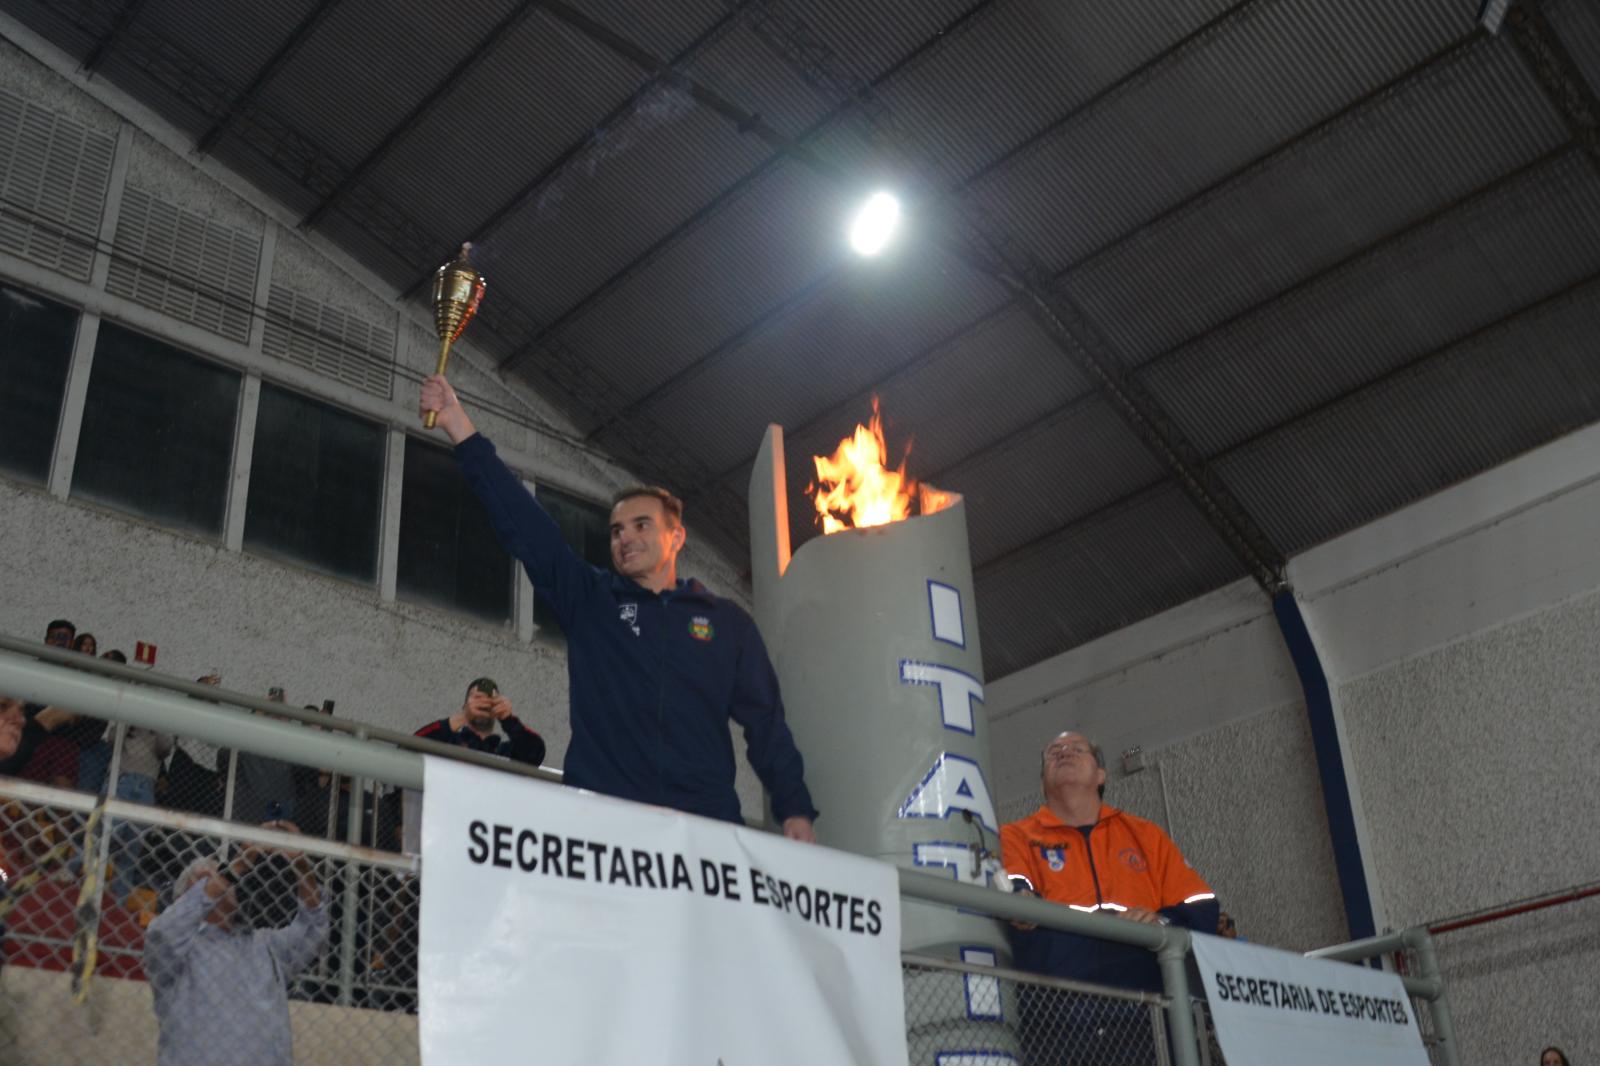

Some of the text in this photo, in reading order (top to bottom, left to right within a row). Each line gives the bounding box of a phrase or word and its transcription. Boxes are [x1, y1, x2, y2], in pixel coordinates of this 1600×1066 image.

[468, 820, 882, 936] SECRETARIA DE ESPORTES
[897, 578, 1022, 1066] ITATI
[1216, 972, 1408, 1024] SECRETARIA DE ESPORTES
